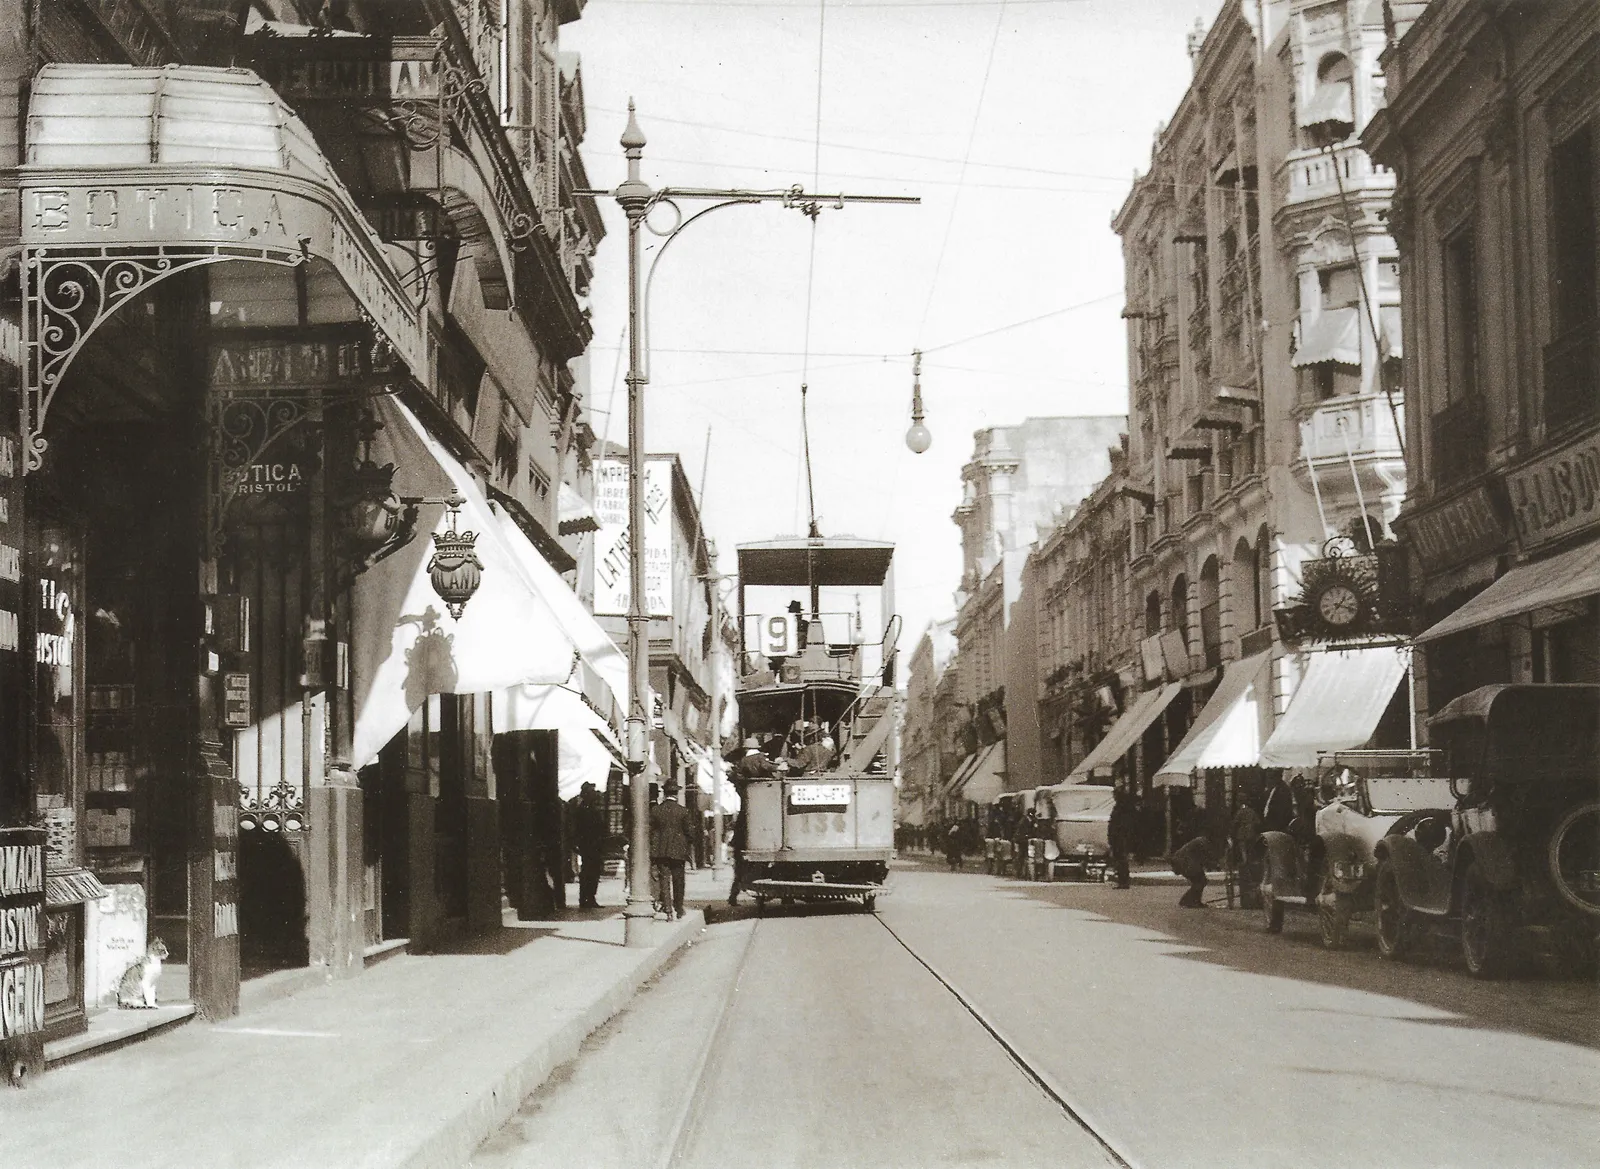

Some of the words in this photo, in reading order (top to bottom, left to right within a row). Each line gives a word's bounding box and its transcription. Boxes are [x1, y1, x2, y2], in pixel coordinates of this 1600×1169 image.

[32, 189, 288, 236] BOTICA
[231, 463, 302, 482] OTICA
[234, 483, 297, 494] RISTOL
[768, 616, 788, 652] 9
